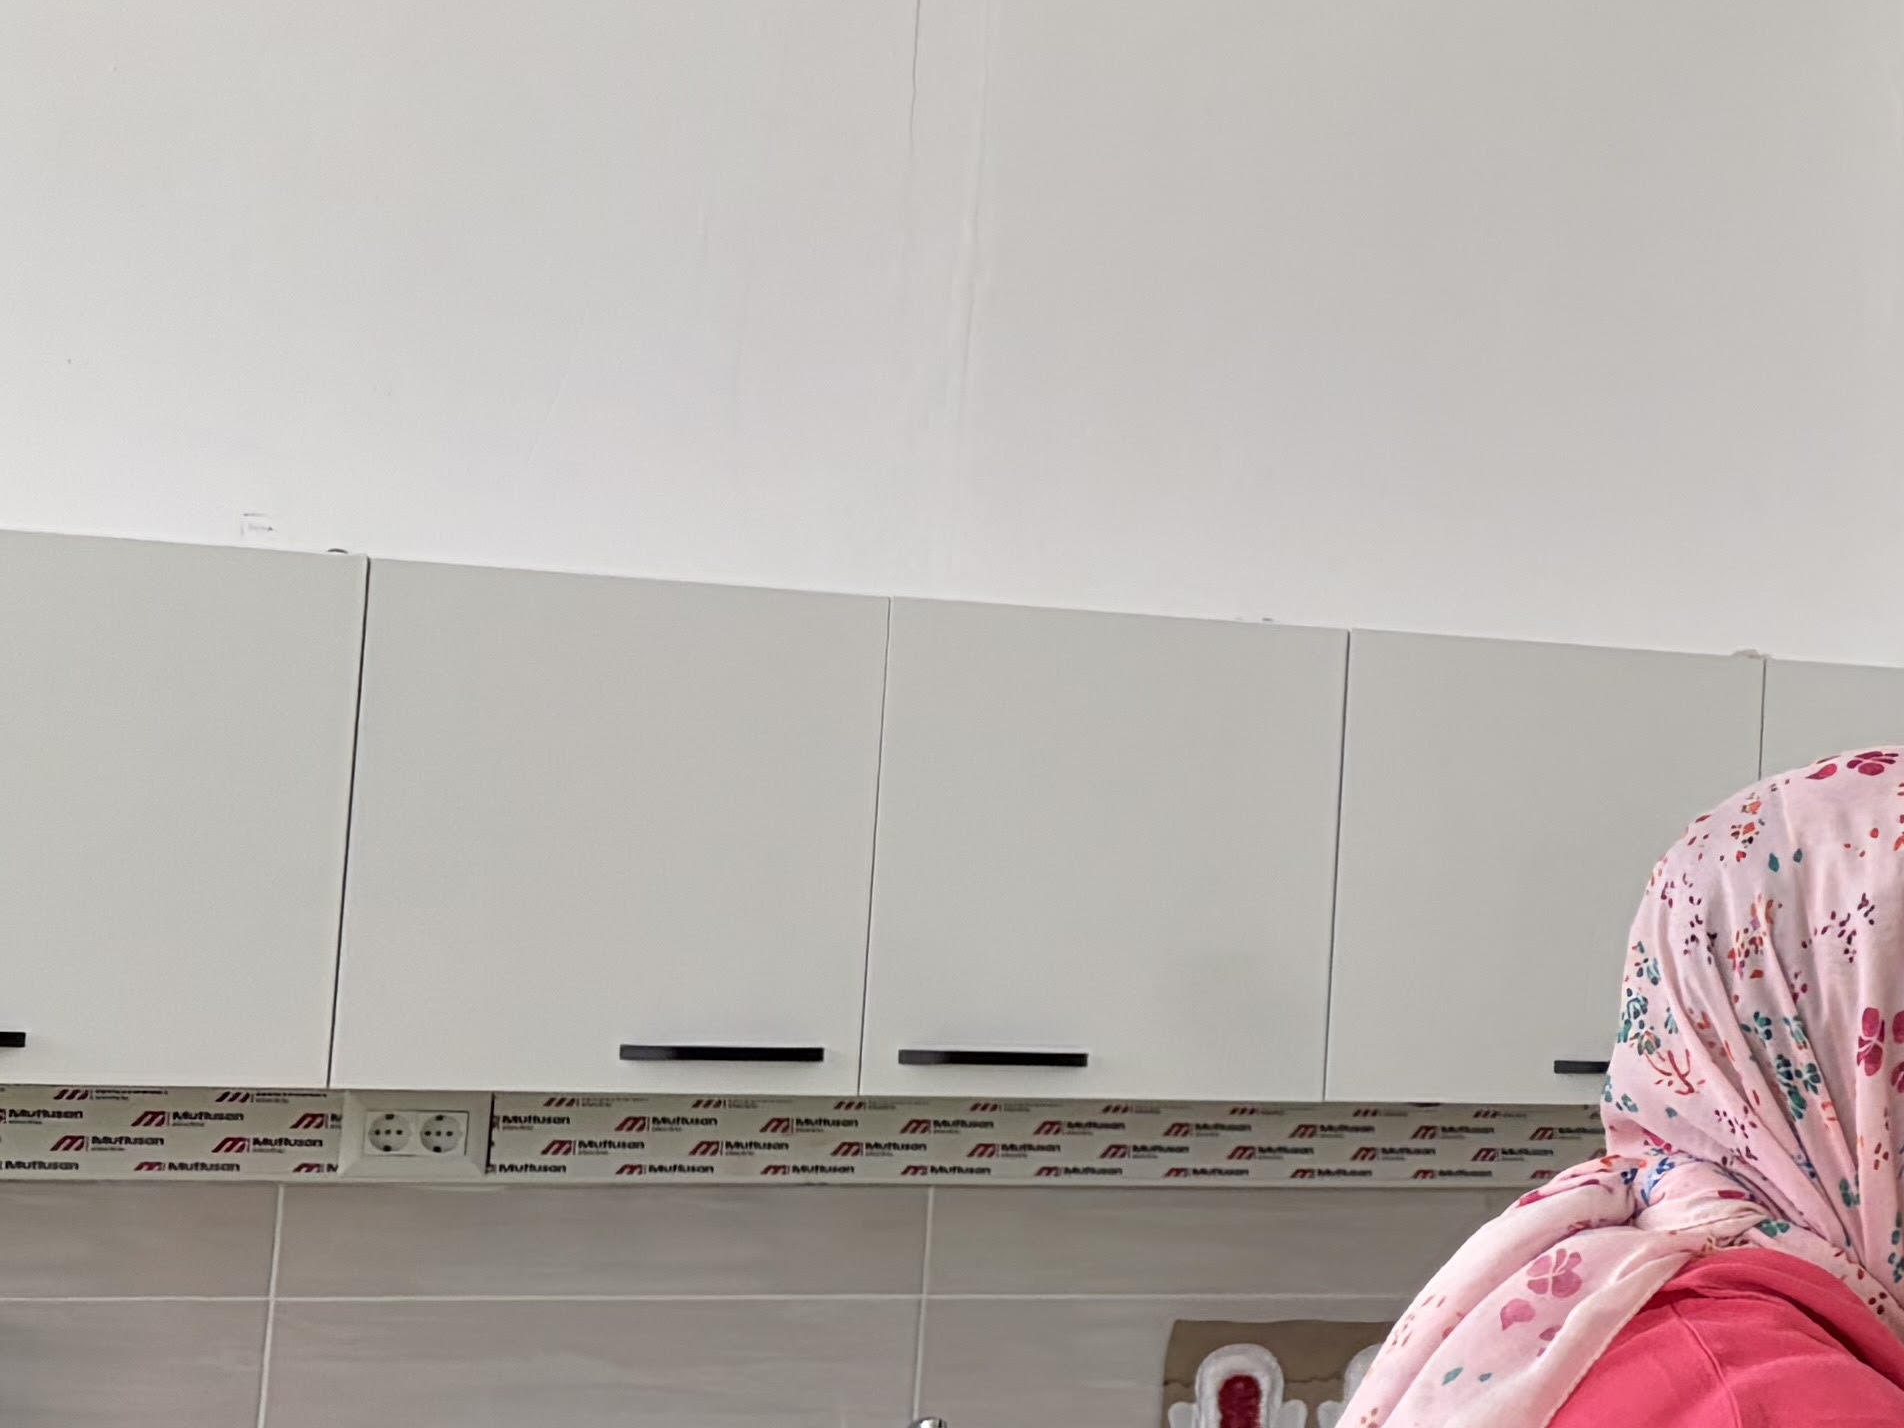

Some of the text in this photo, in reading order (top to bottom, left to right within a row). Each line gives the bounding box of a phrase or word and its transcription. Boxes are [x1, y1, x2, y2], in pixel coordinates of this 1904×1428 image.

[502, 1114, 571, 1126] Mutlusan
[252, 1136, 323, 1148] Mutlusan
[578, 1139, 645, 1151] Mutlusan
